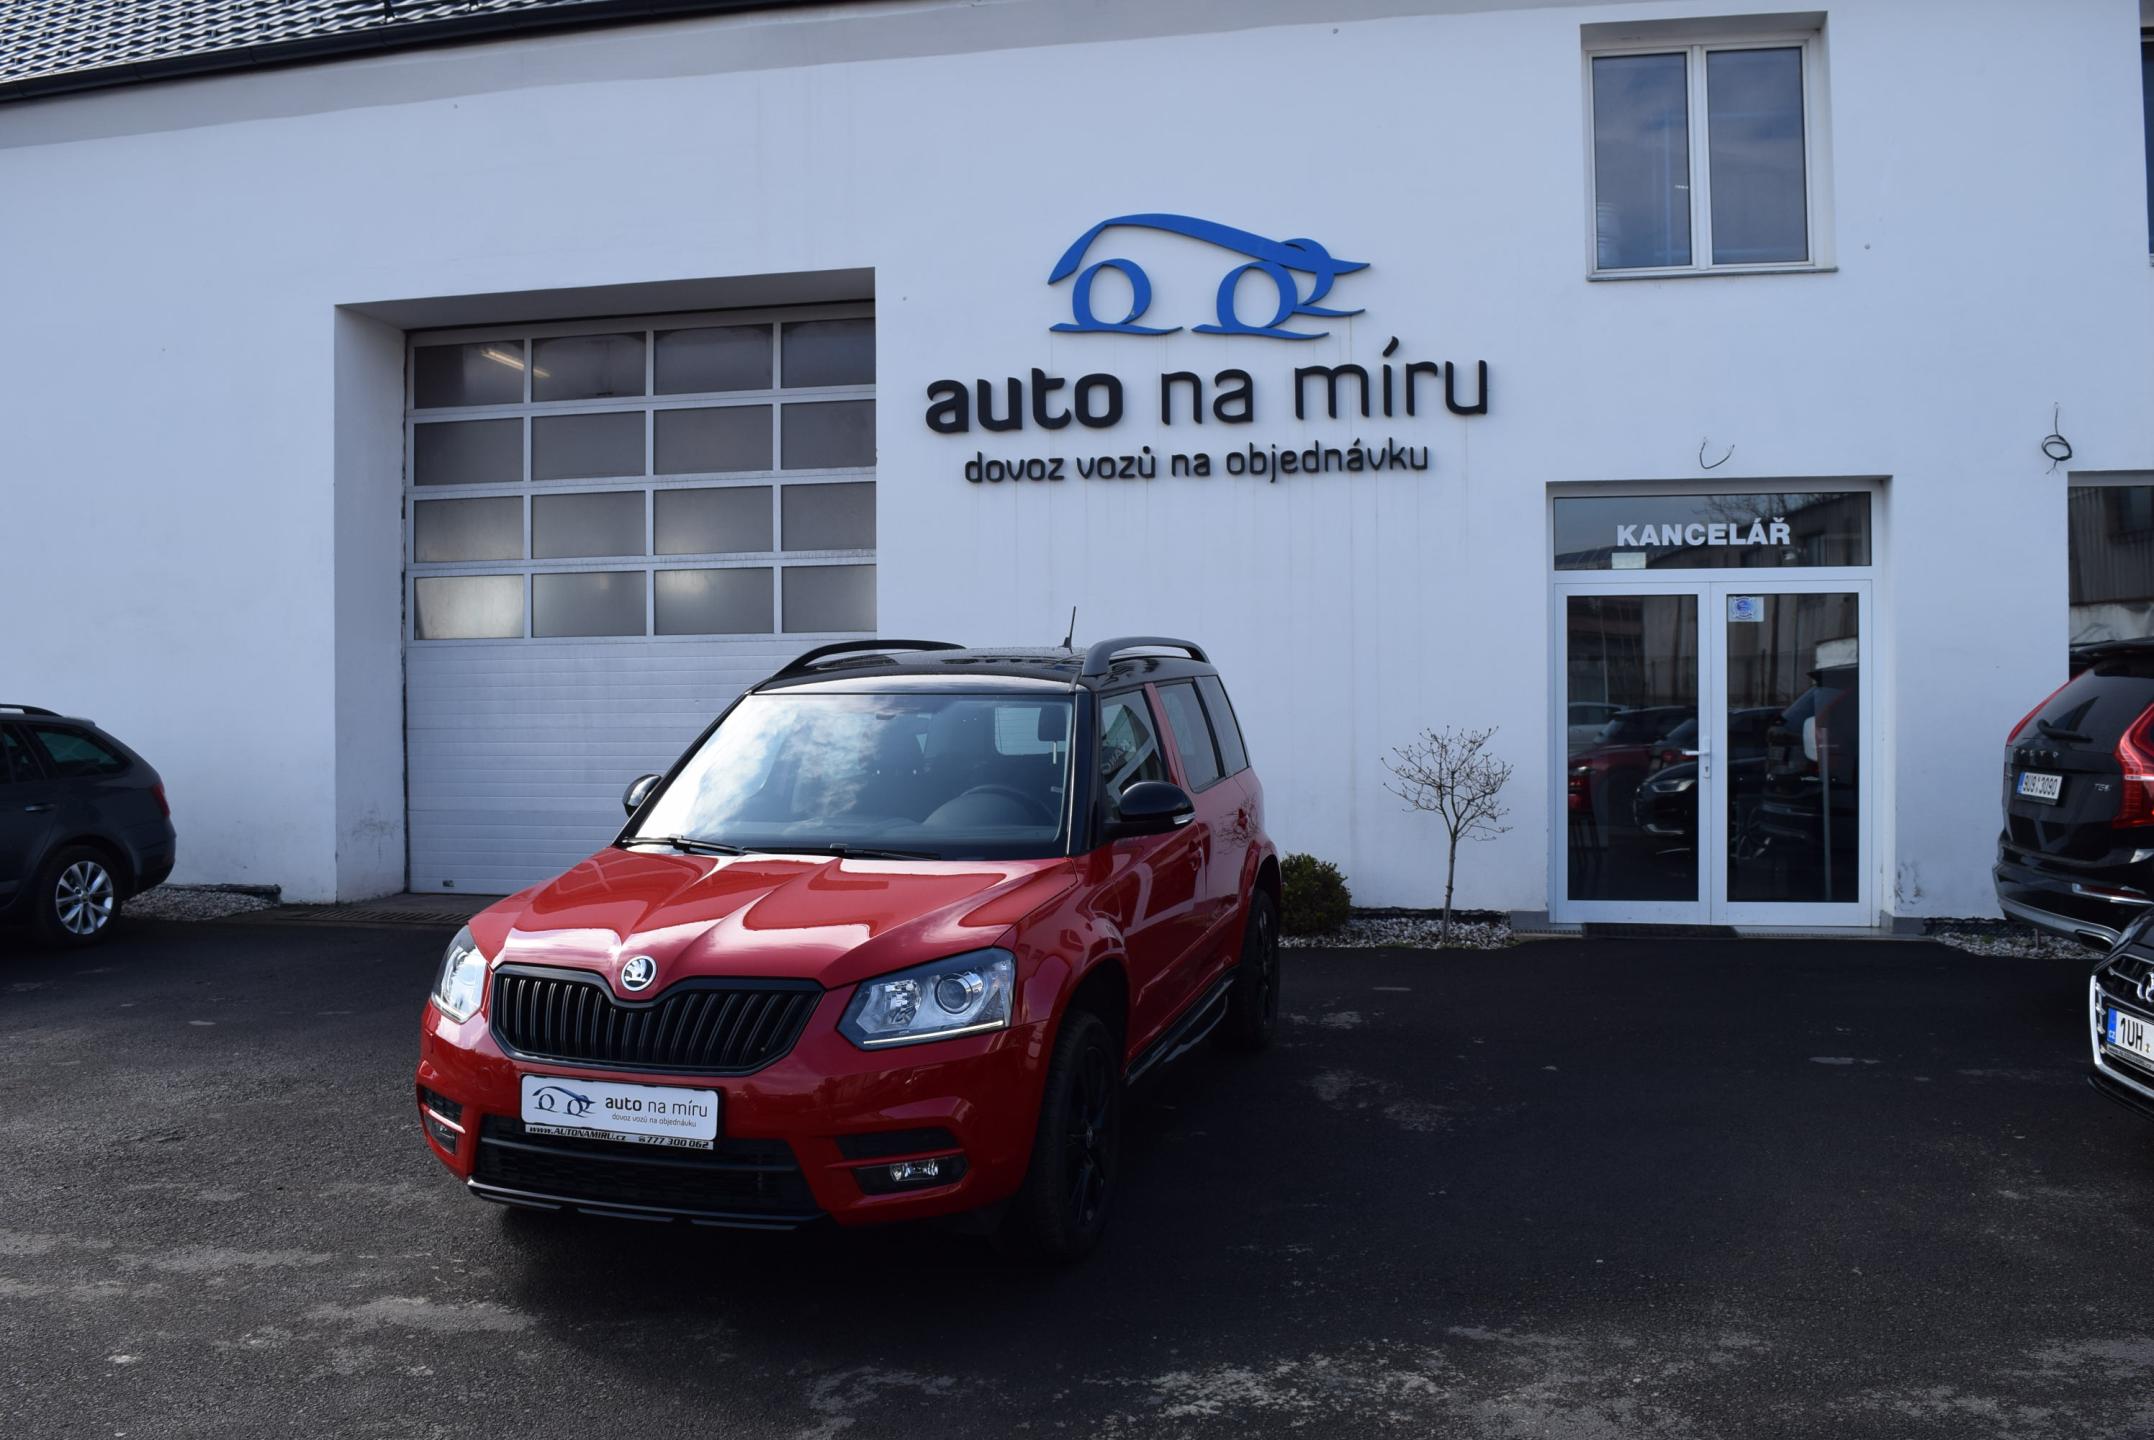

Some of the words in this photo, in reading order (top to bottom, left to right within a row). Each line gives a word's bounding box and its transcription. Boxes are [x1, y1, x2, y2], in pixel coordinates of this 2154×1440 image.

[925, 367, 1123, 433] auto
[1161, 369, 1254, 426] na
[1294, 336, 1487, 420] míru
[964, 451, 1064, 484] dovoz
[1077, 446, 1156, 480] vozů
[1171, 451, 1211, 478] na
[1225, 437, 1429, 484] objednávku
[1616, 517, 1791, 546] KANCELÁŘ
[2120, 1017, 2143, 1051] 1UH
[605, 1096, 642, 1112] auto
[648, 1101, 666, 1114] na
[672, 1099, 708, 1117] míru
[612, 1112, 631, 1121] dovoz
[659, 1118, 697, 1128] objednávku
